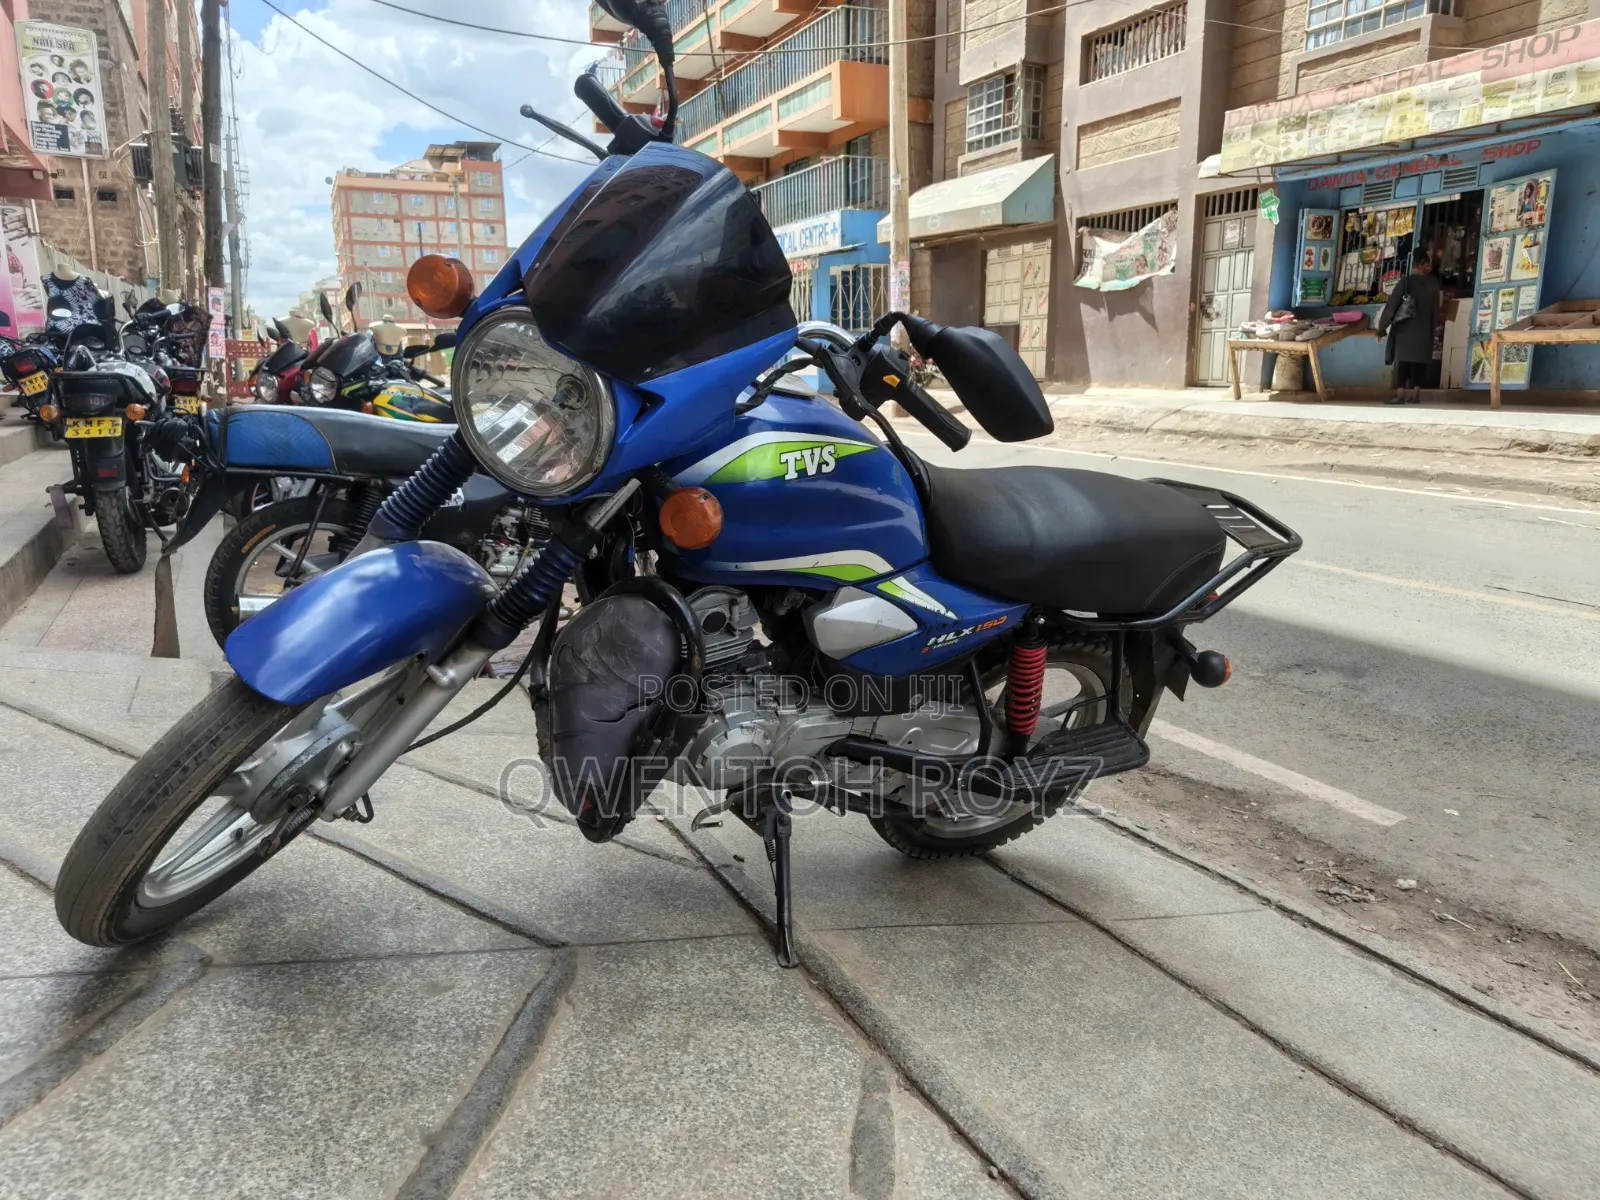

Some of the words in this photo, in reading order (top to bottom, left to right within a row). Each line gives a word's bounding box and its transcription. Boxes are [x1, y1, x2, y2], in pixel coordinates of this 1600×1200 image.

[56, 40, 75, 51] SPA
[1333, 58, 1458, 105] GENERAL
[1481, 24, 1582, 70] SHOP
[1375, 153, 1463, 181] GENERAL
[1481, 138, 1542, 161] SHOP
[800, 223, 829, 251] CENTRE
[780, 444, 836, 480] TVS
